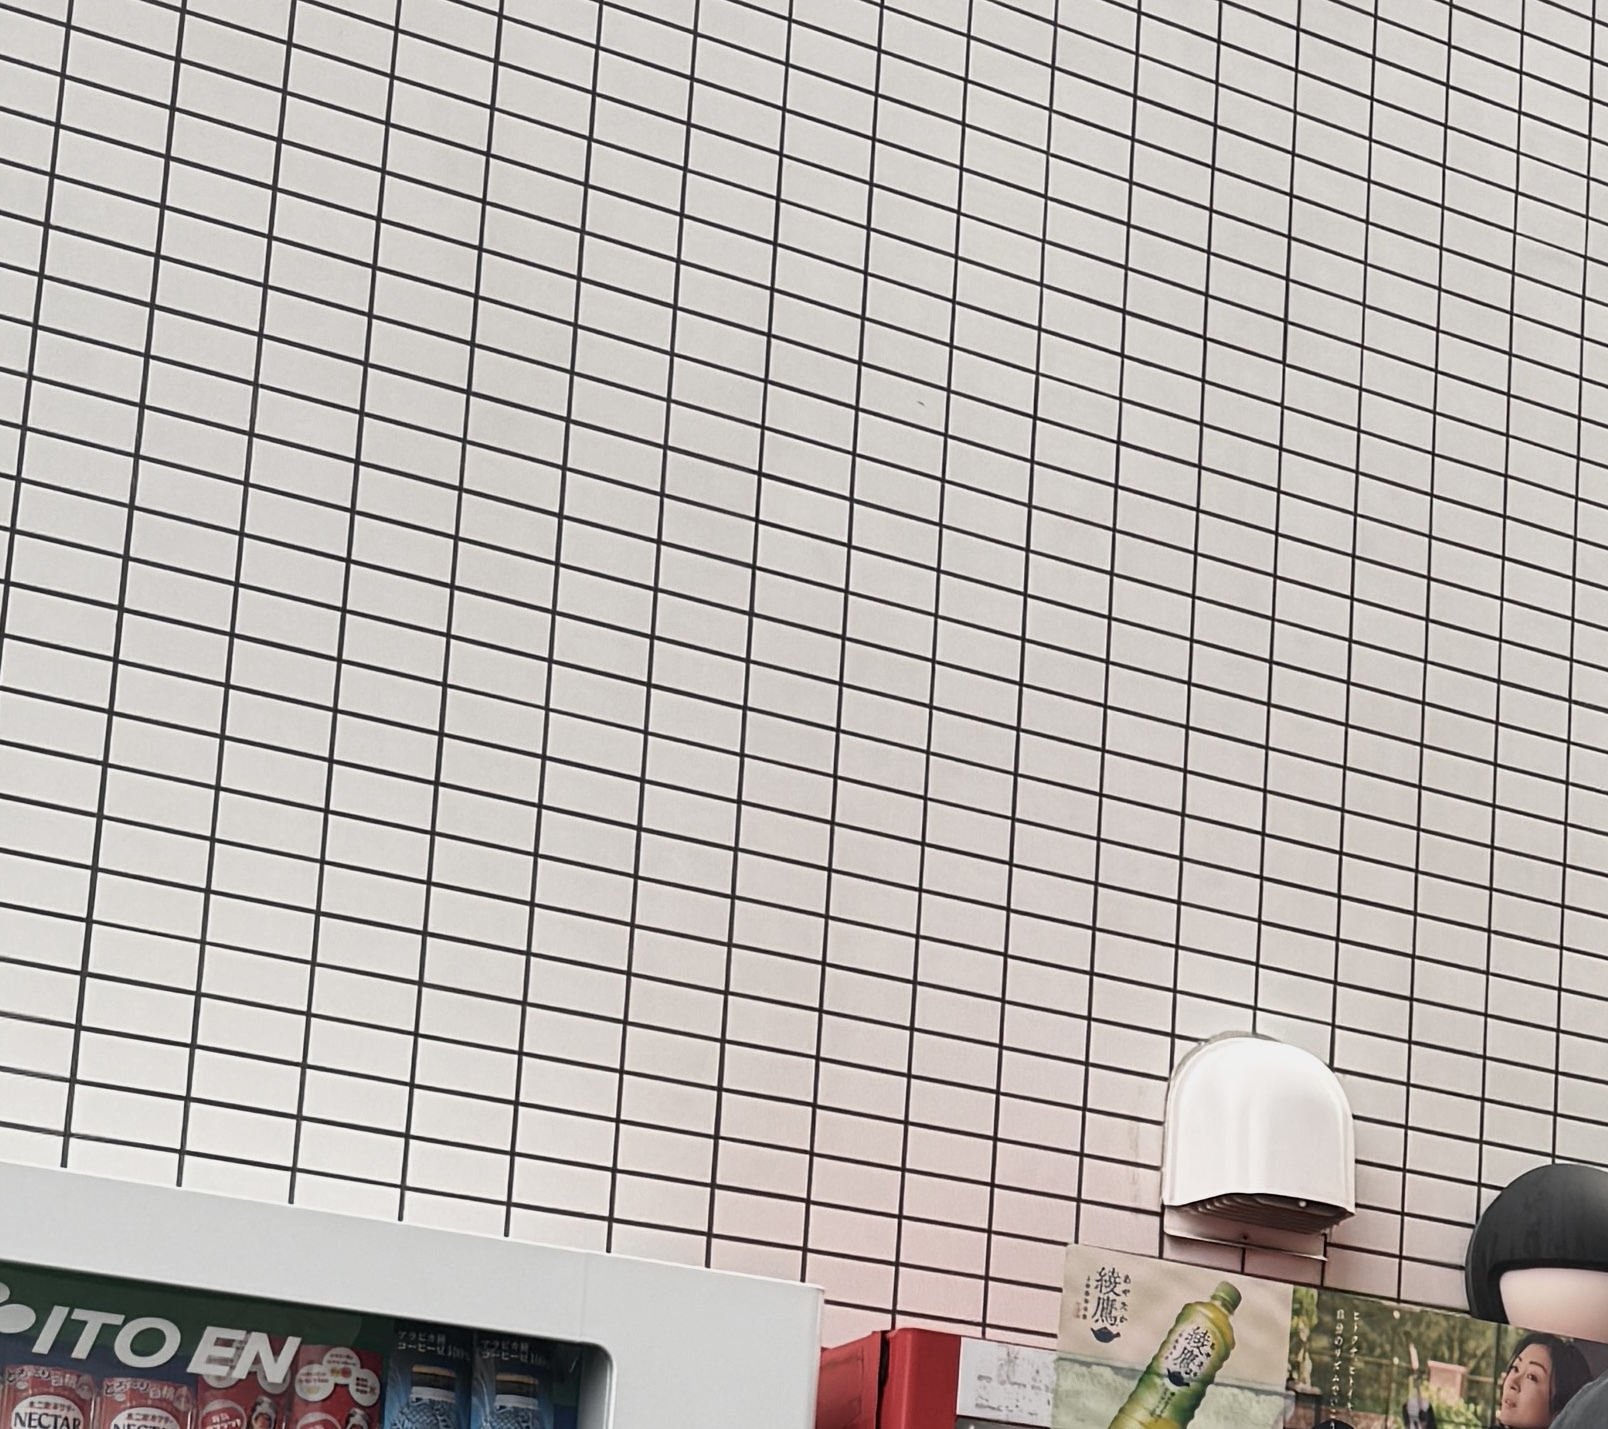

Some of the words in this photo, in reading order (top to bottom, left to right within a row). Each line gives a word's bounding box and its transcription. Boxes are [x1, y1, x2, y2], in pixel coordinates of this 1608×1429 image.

[1091, 1266, 1122, 1327] 綾鷹
[31, 1305, 182, 1368] ITO
[187, 1326, 302, 1384] EN
